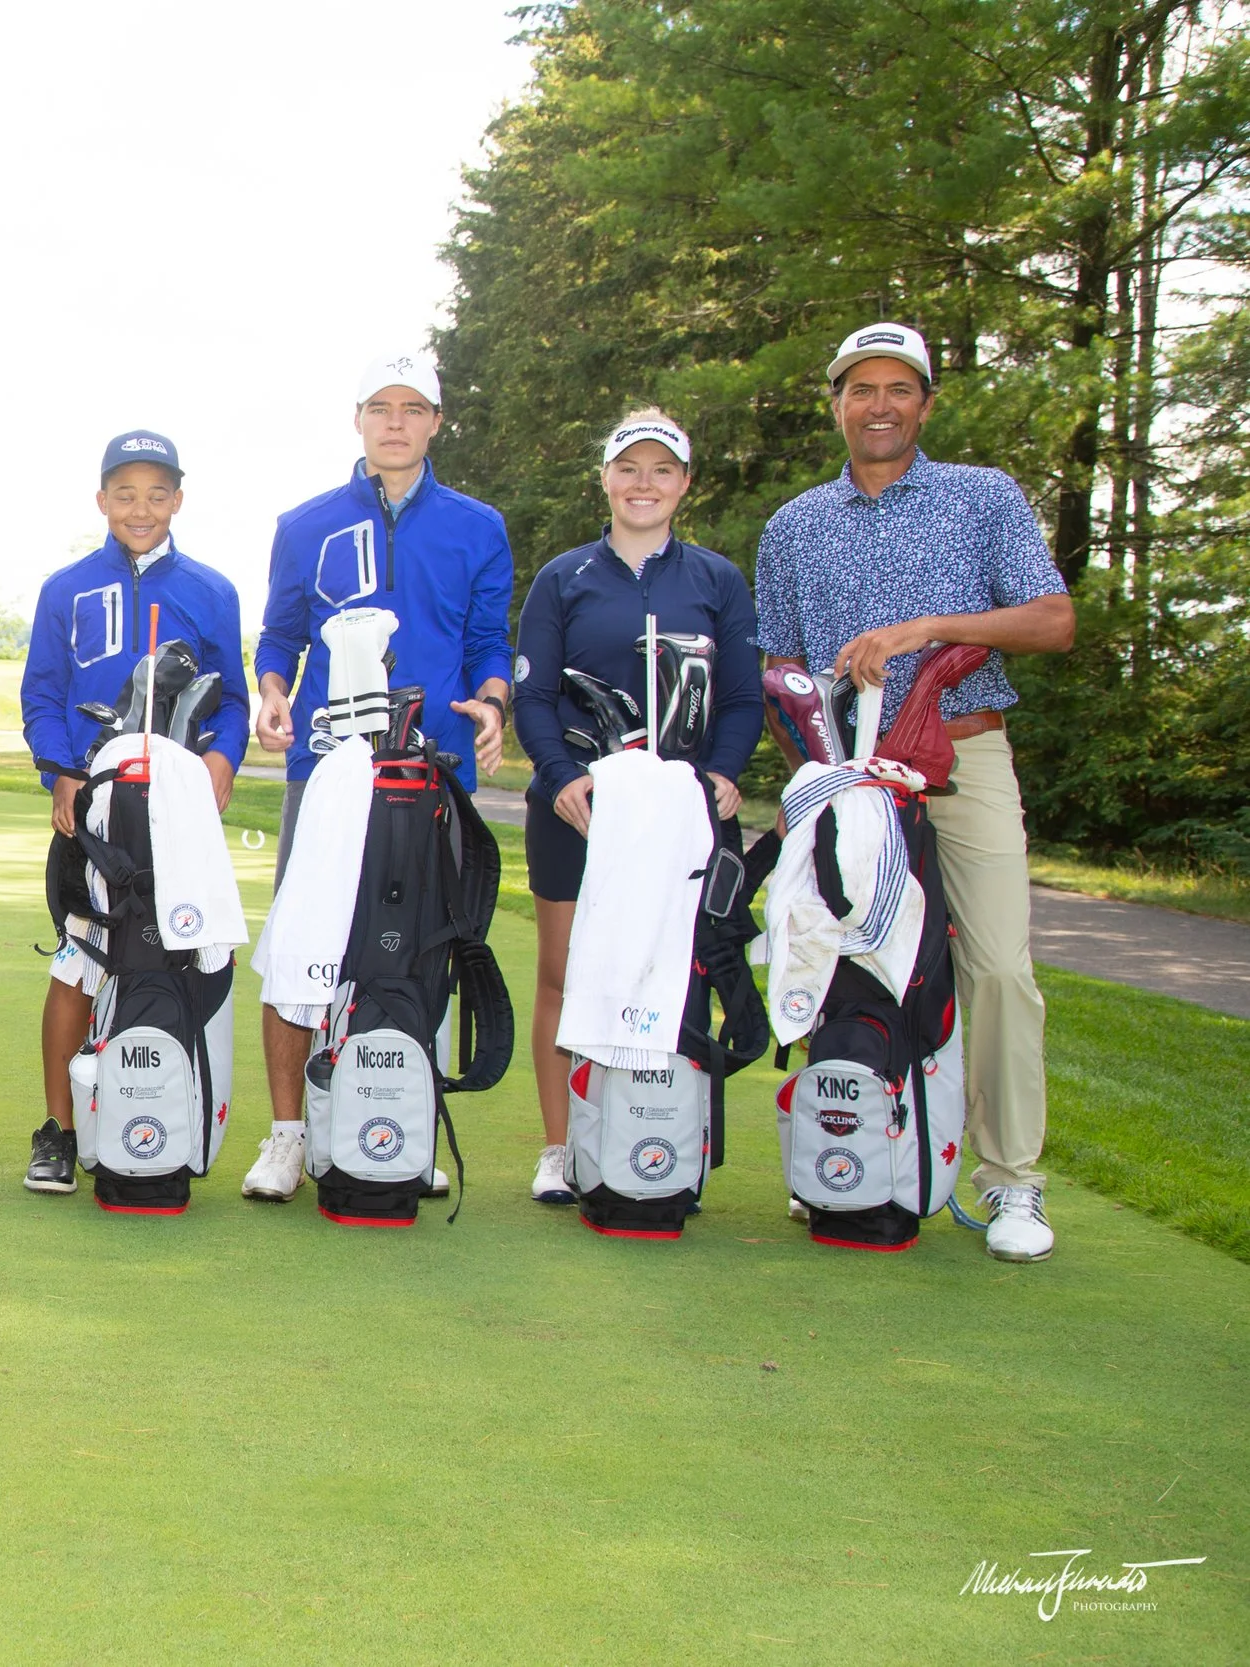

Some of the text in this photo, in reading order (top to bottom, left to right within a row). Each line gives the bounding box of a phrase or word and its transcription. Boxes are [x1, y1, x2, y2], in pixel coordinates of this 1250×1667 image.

[614, 426, 680, 444] TaylorMade
[121, 1046, 161, 1069] Mills
[357, 1045, 405, 1069] Nicoara
[632, 1069, 674, 1088] McKay
[817, 1075, 860, 1101] KING
